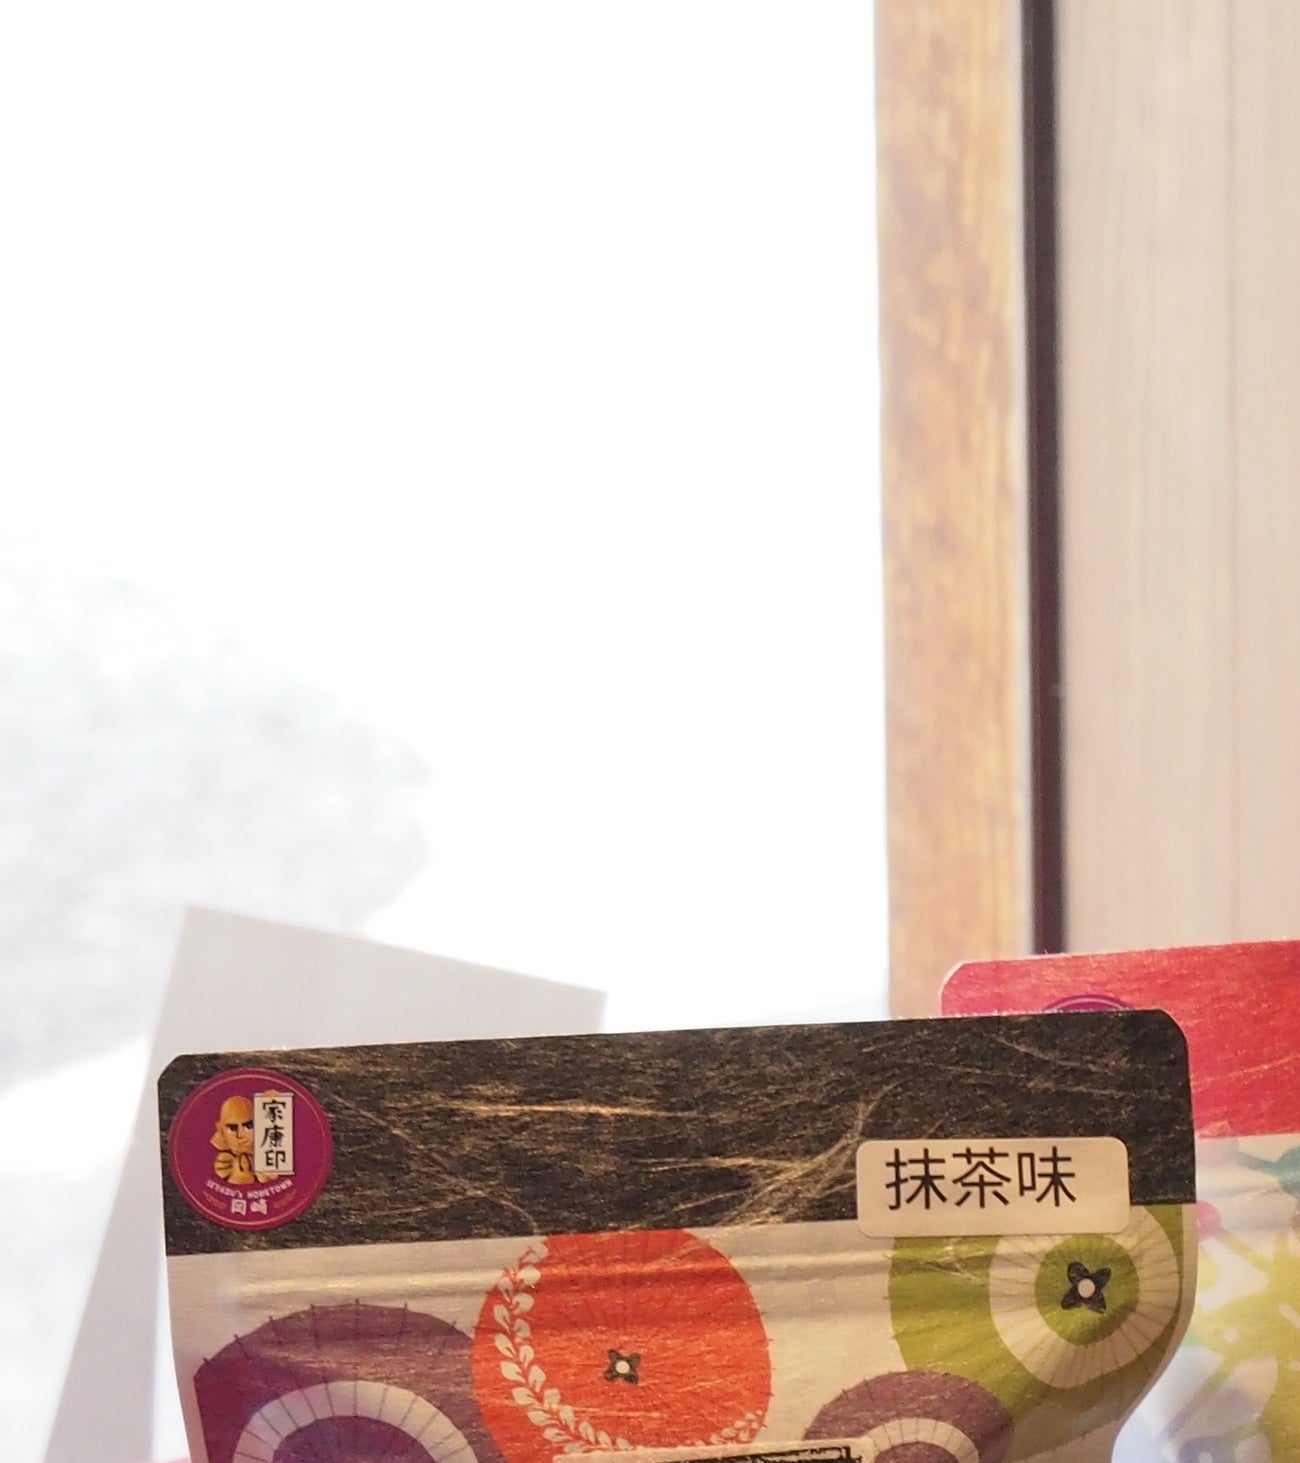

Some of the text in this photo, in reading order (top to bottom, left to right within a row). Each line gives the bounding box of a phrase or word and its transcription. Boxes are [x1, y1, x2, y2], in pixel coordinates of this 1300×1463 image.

[260, 1099, 287, 1170] 家康印
[885, 1145, 1077, 1210] 抹茶味
